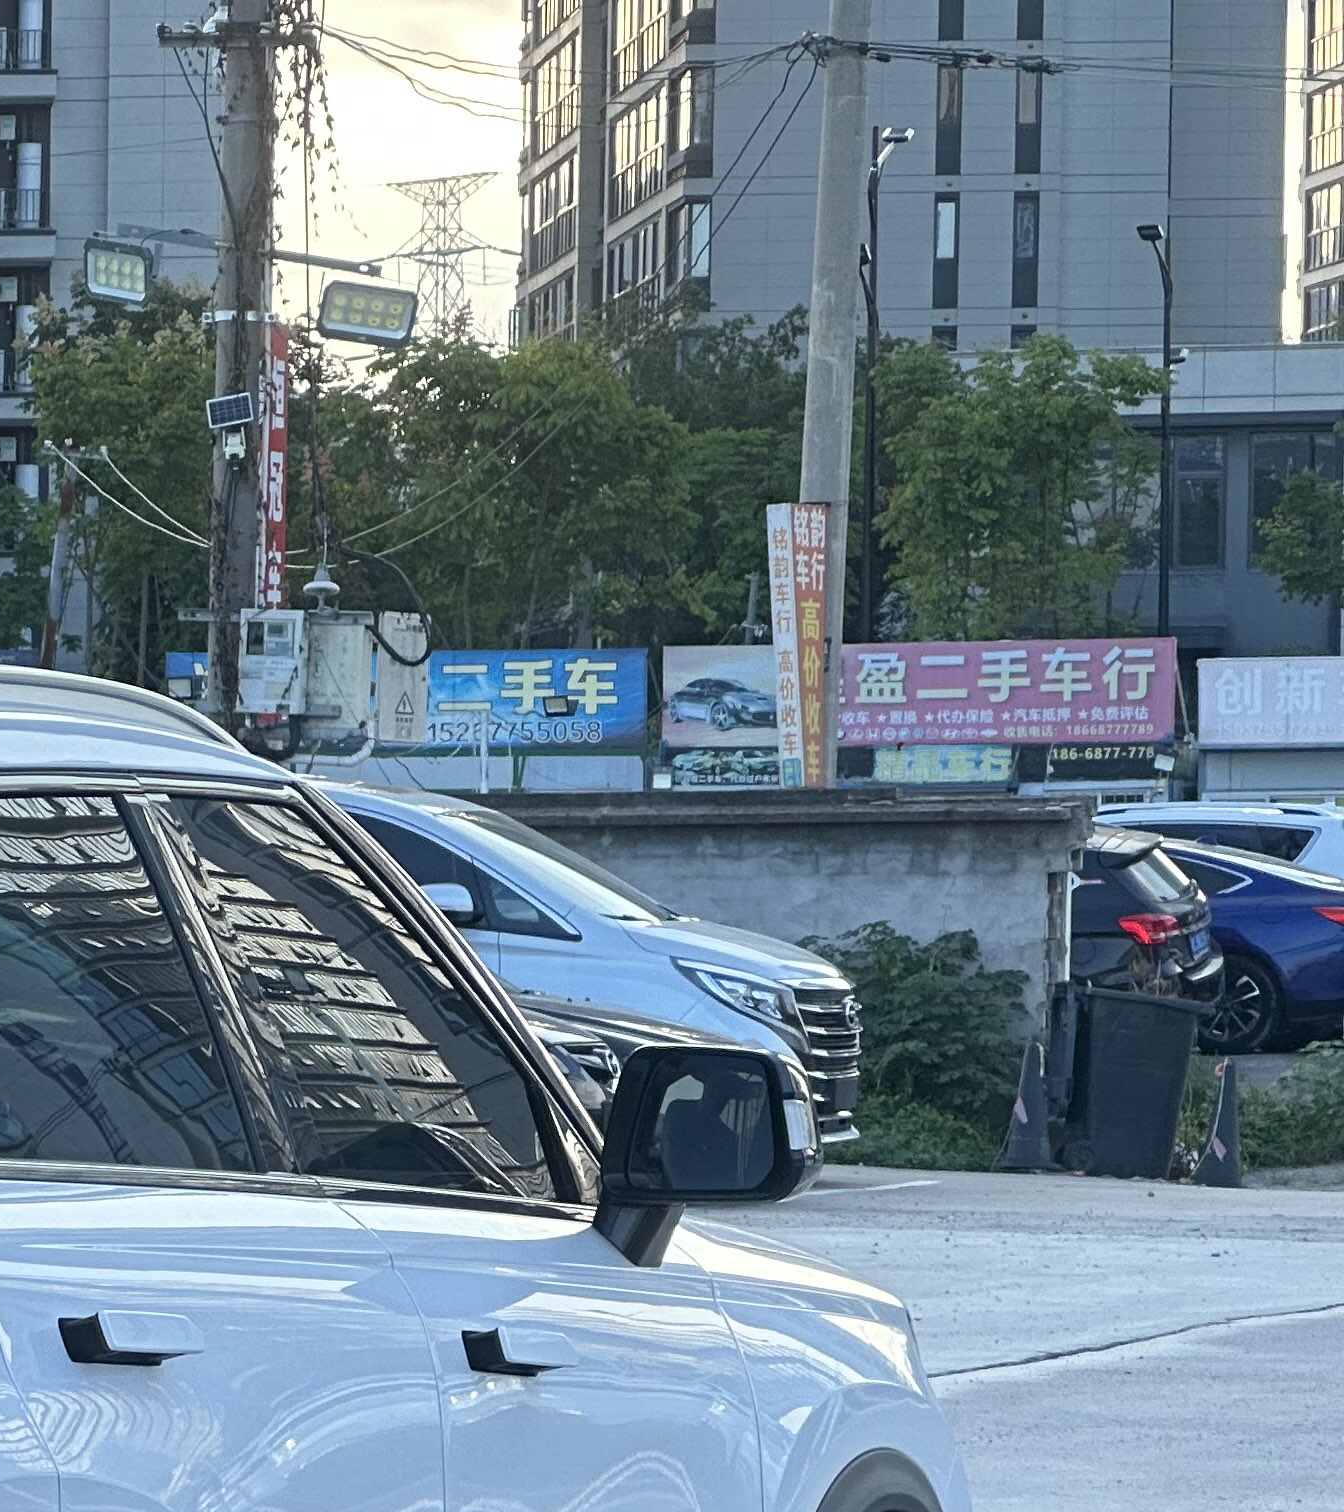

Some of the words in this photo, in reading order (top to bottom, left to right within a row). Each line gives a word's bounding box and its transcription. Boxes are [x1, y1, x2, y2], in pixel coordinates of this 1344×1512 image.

[795, 550, 825, 592] 车行
[438, 657, 618, 715] 二手车
[778, 650, 798, 756] 高价收车
[800, 599, 821, 784] 高价收车
[840, 645, 1156, 704] 盈二手车行
[1214, 667, 1344, 716] 创新
